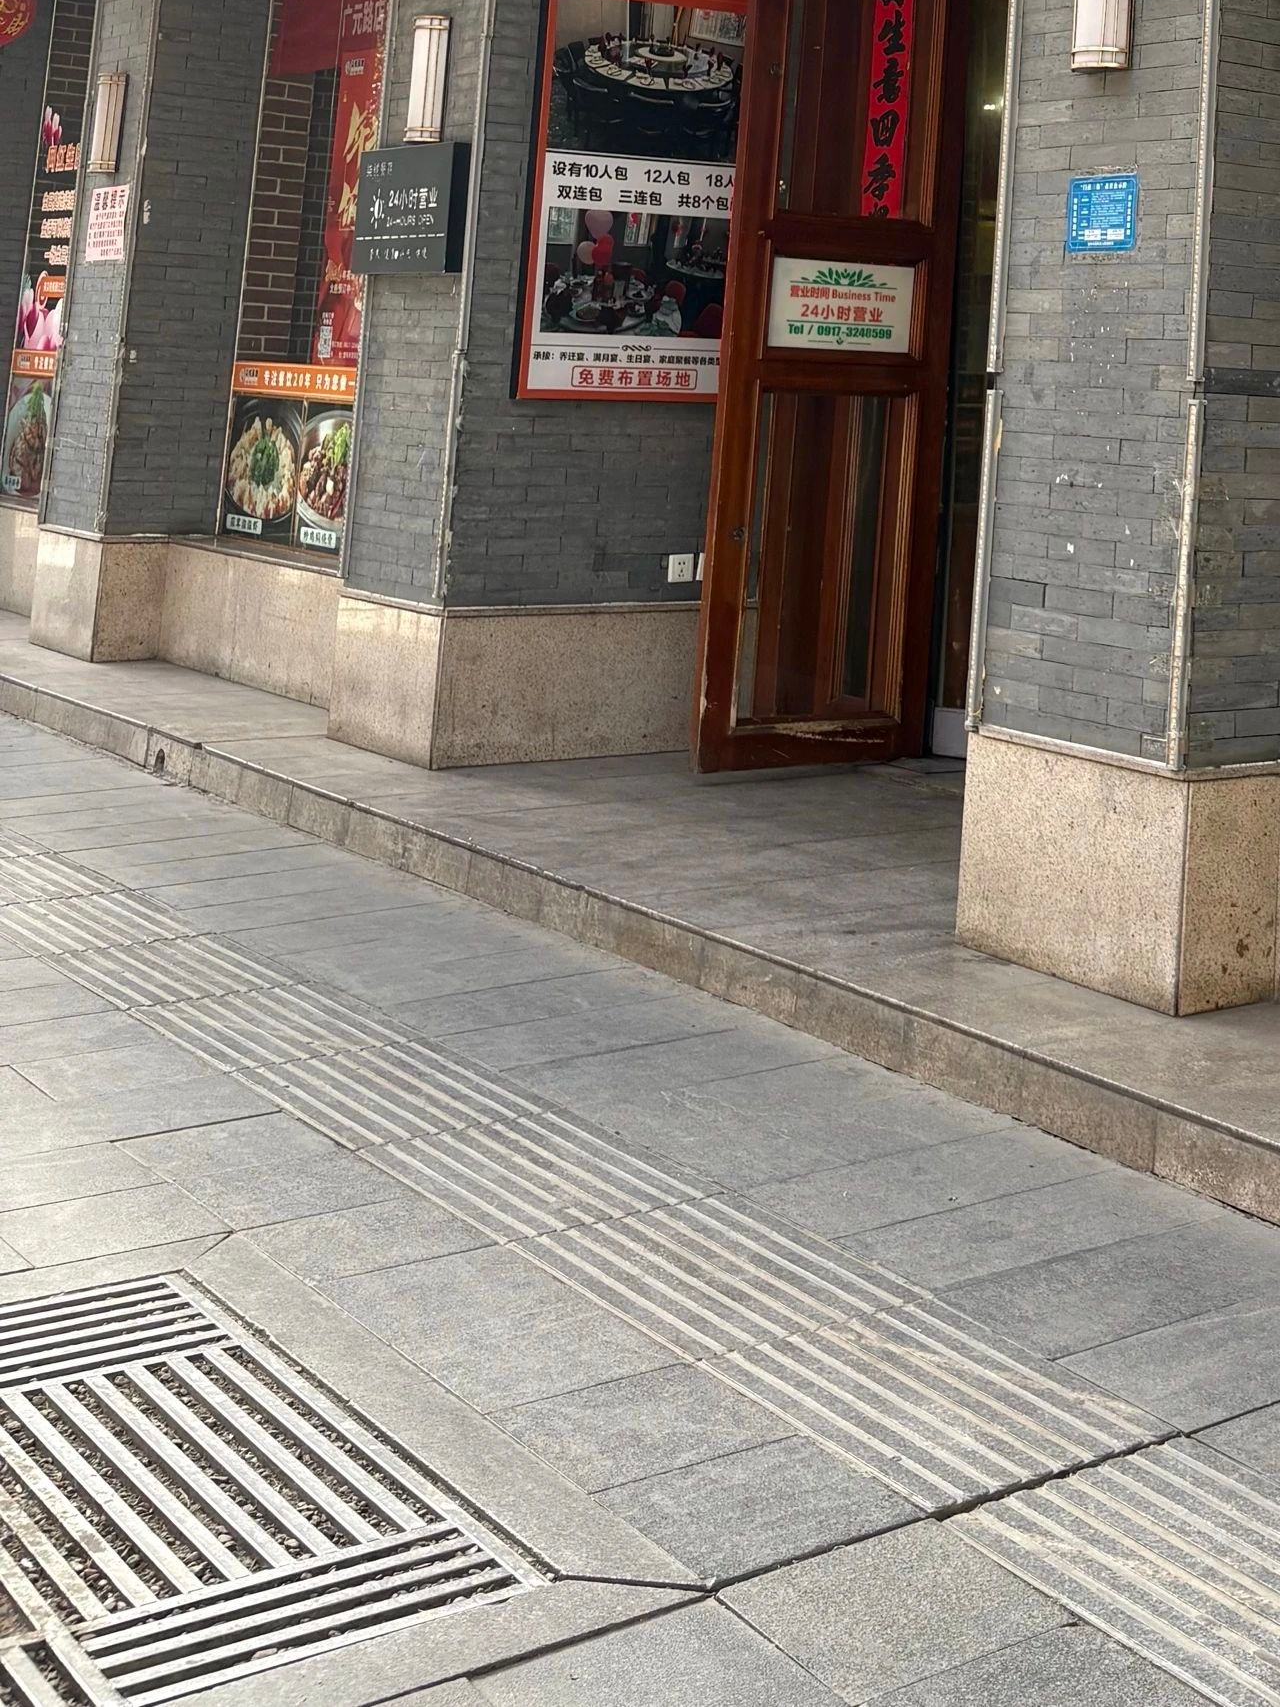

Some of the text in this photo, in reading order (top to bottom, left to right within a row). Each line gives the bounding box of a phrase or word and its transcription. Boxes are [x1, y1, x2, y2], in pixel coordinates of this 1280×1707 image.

[552, 160, 628, 181] 设有10人包
[644, 169, 691, 186] 12人包
[557, 184, 734, 211] 双连包 三连包 共8个包
[832, 289, 872, 301] Business
[874, 292, 896, 303] Time
[801, 304, 883, 323] 24小时营业
[788, 324, 804, 335] Tel
[578, 368, 691, 387] 免费布置场地
